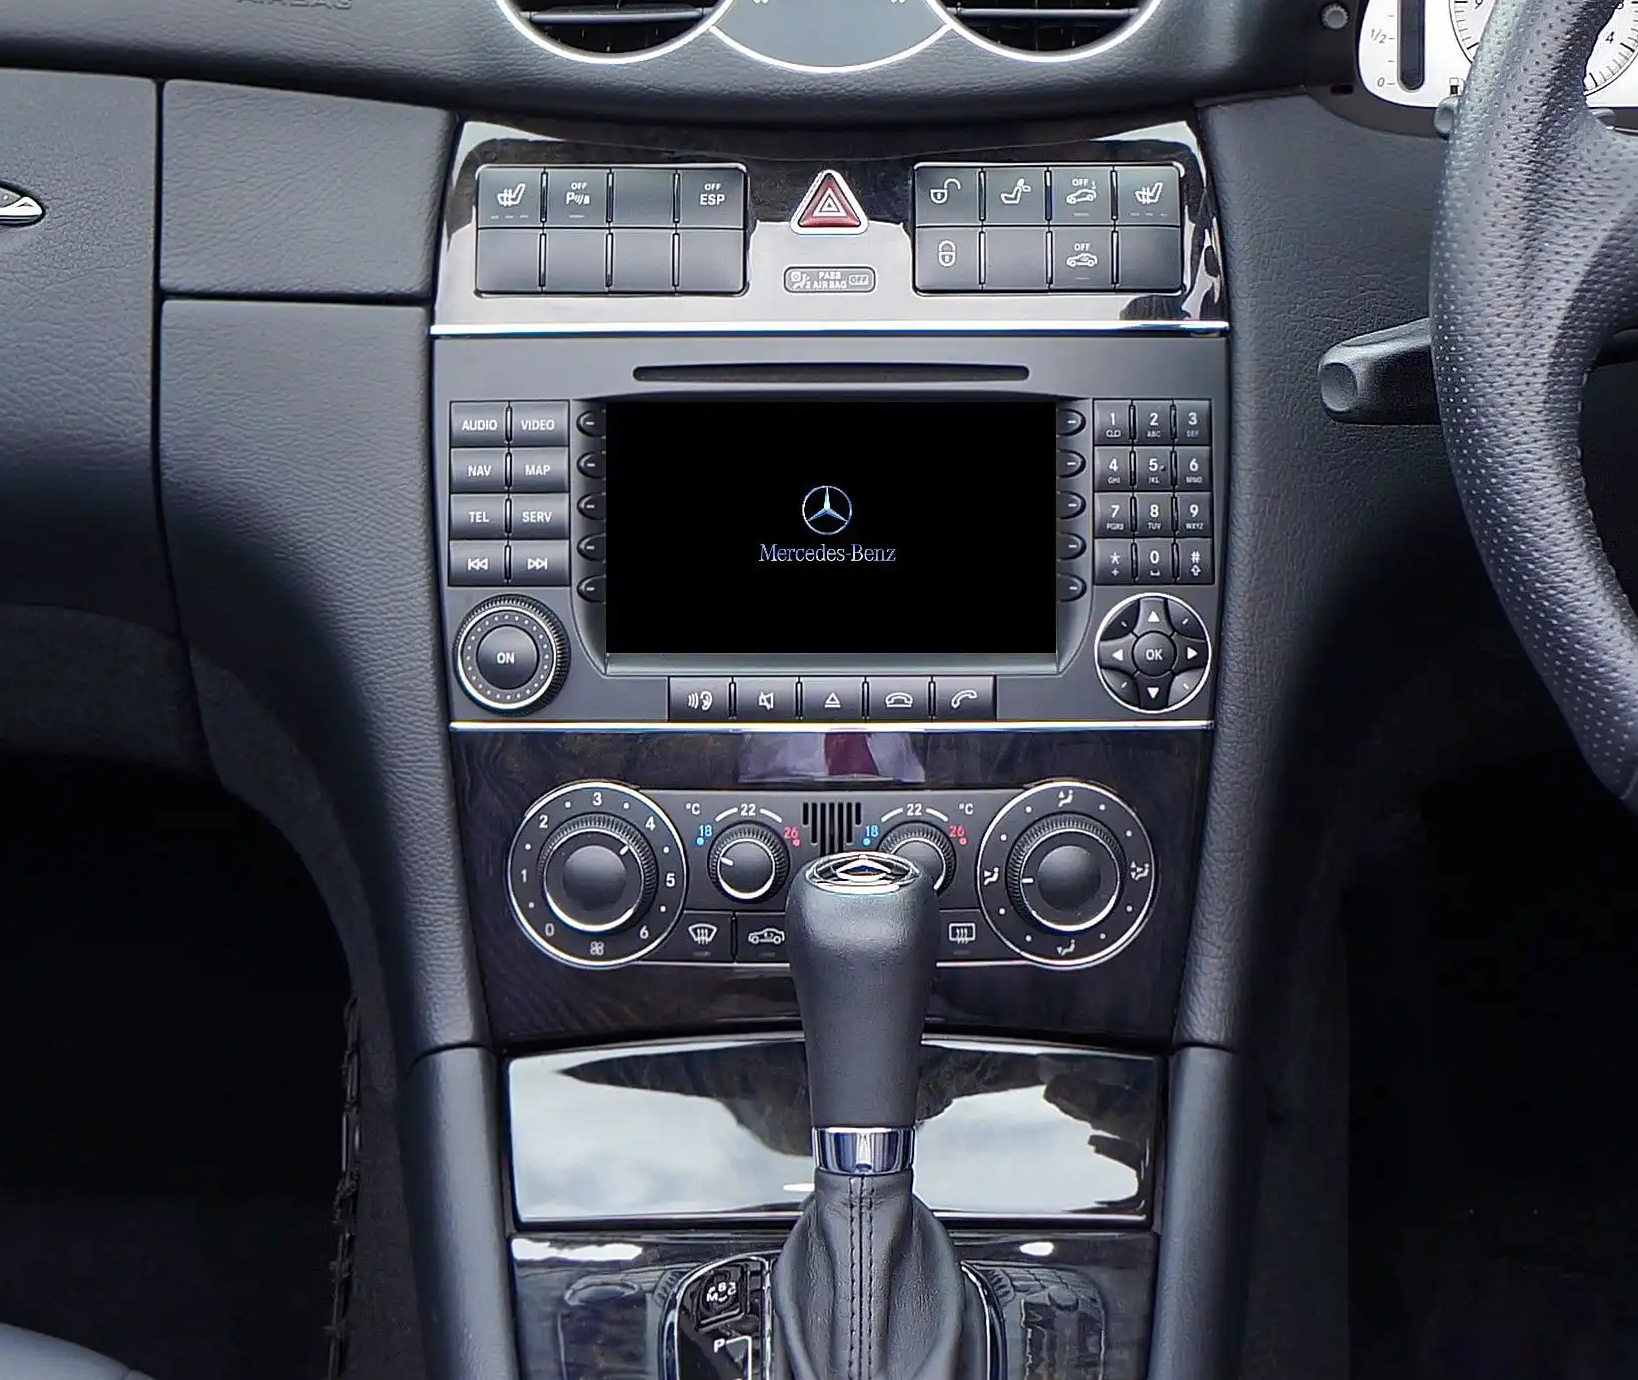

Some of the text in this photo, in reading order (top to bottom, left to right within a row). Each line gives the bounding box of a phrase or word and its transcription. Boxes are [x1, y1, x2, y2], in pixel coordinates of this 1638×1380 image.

[1370, 28, 1388, 44] 1/2
[1605, 31, 1615, 45] 4
[1072, 177, 1090, 188] OFF
[699, 193, 726, 206] ESP
[1074, 242, 1091, 252] OFF
[461, 419, 498, 431] AUDIO
[520, 419, 555, 431] VIDEO
[1110, 412, 1116, 426] 1
[1149, 412, 1159, 426] 2
[1188, 412, 1198, 426] 3
[467, 465, 492, 477] NAV
[525, 464, 551, 476] MAP
[1109, 458, 1119, 472] 4
[1149, 458, 1158, 472] 5
[1189, 458, 1199, 472] 6
[468, 510, 490, 522] TEL
[522, 510, 553, 523] SERV
[1110, 504, 1120, 518] 7
[1150, 504, 1159, 518] 8
[1189, 504, 1199, 518] 9
[758, 543, 898, 562] Mercedes-Benz
[1150, 551, 1160, 565] 0
[497, 651, 515, 664] ON
[1146, 649, 1163, 661] OK
[592, 792, 603, 806] 3
[740, 803, 756, 816] 22
[906, 803, 923, 816] 22
[539, 814, 549, 829] 2
[645, 816, 656, 831] 4
[698, 824, 712, 837] 18
[783, 827, 798, 839] 26
[865, 825, 879, 837] 18
[949, 825, 965, 838] 26
[520, 869, 528, 883] 1
[666, 872, 676, 888] 5
[545, 922, 555, 937] 0
[639, 925, 649, 940] 6
[713, 1338, 725, 1353] P
